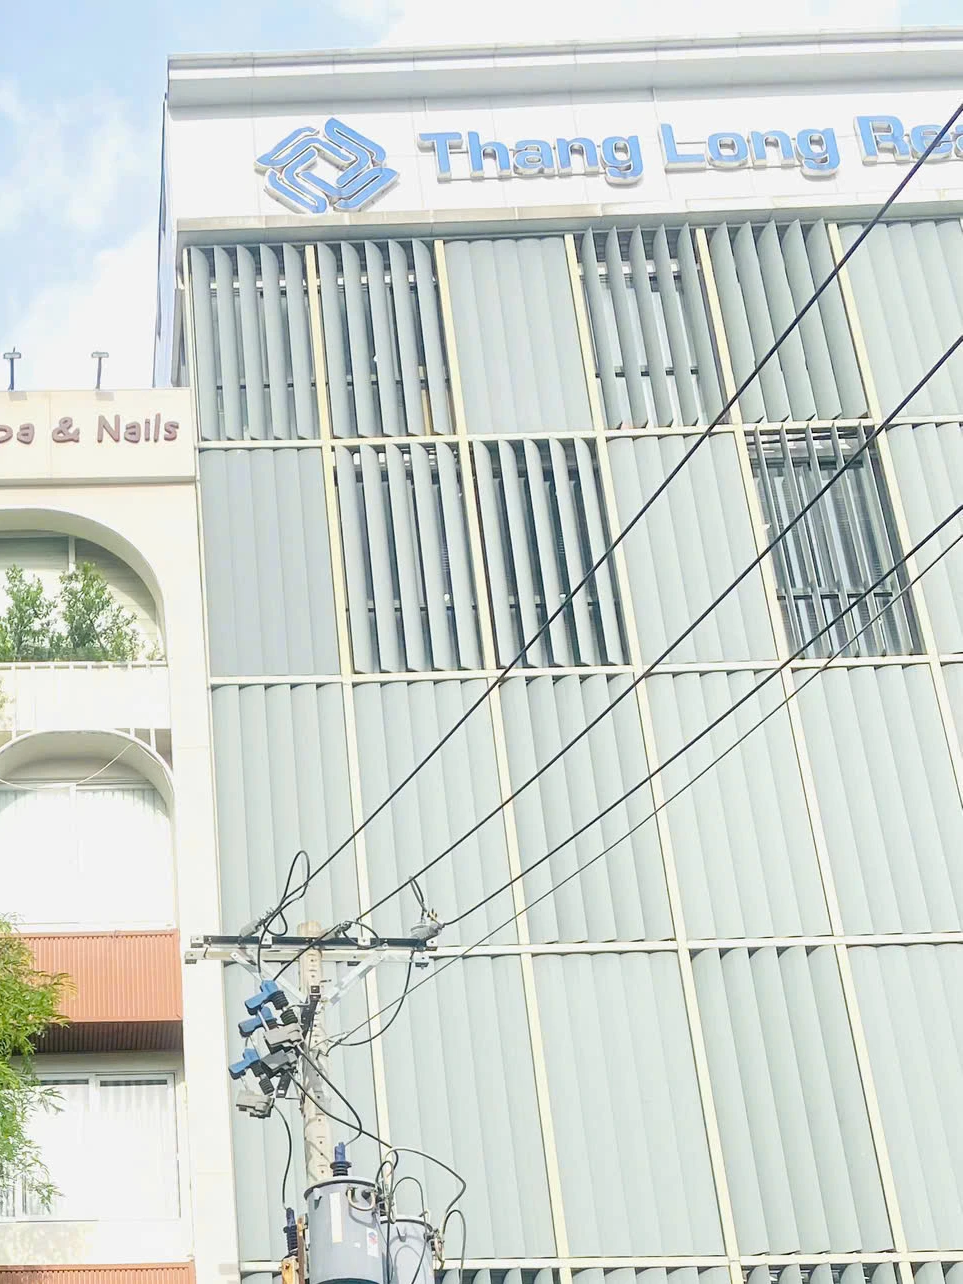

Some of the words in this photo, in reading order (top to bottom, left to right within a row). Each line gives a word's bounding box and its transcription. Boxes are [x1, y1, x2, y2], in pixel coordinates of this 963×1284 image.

[418, 131, 644, 186] Thang
[659, 124, 841, 177] Long
[853, 114, 963, 166] Re
[51, 415, 81, 444] &
[96, 412, 180, 443] Nails
